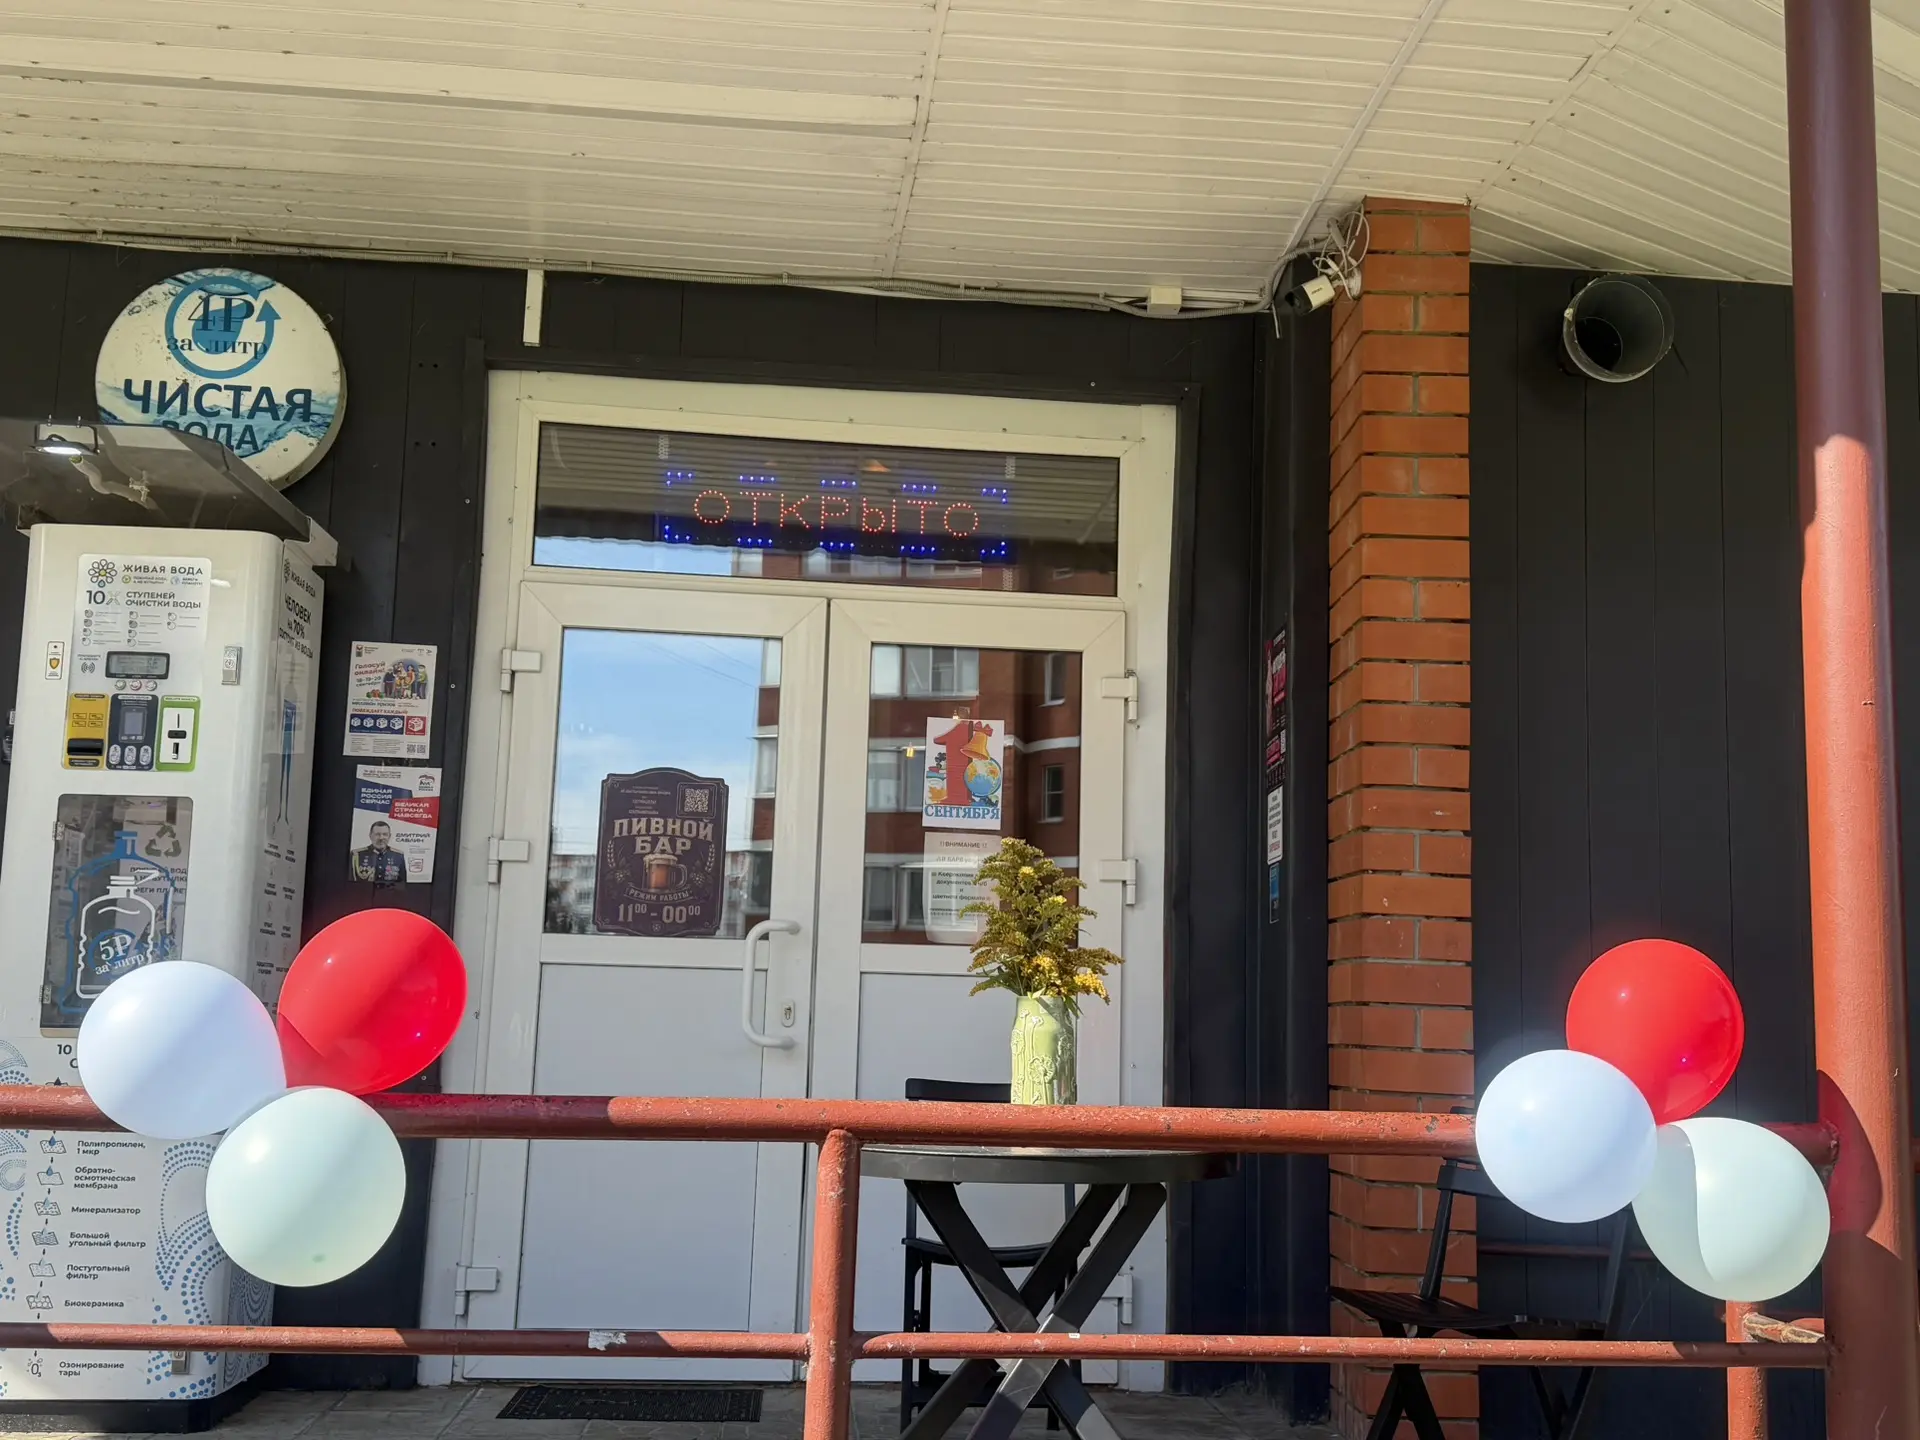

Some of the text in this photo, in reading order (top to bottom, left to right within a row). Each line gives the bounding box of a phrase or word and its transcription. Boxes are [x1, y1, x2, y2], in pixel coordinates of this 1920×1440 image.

[166, 337, 267, 360] за литр
[123, 378, 312, 423] ЧИСТАЯ
[693, 489, 979, 537] ОТКРЫТО
[122, 564, 203, 576] ЖИВАЯ ВОДА
[86, 590, 106, 605] 10
[126, 590, 176, 600] СТУПЕНЕЙ
[125, 599, 201, 609] ОЧИСТКИ ВОДЫ
[285, 593, 312, 625] ЧЕЛОВЕК
[293, 620, 305, 639] 70%
[924, 805, 1001, 820] СЕНТЯБРЯ
[613, 817, 714, 842] ПИВНОЙ
[634, 836, 692, 856] БАР
[629, 888, 690, 901] РЕЖИМ РАБОТЫ
[95, 953, 145, 975] за литр
[57, 1044, 73, 1055] 10
[77, 1140, 146, 1149] Полипропилен,
[75, 1166, 116, 1175] Обратно-
[74, 1181, 119, 1190] мембрана
[71, 1206, 141, 1215] Минерализатор
[69, 1231, 110, 1239] Большой
[68, 1239, 146, 1249] угольный фильтр
[66, 1264, 131, 1273] Постугольный
[66, 1272, 99, 1280] фильтр
[64, 1299, 125, 1308] Биокерамика
[59, 1361, 125, 1370] Озонирование
